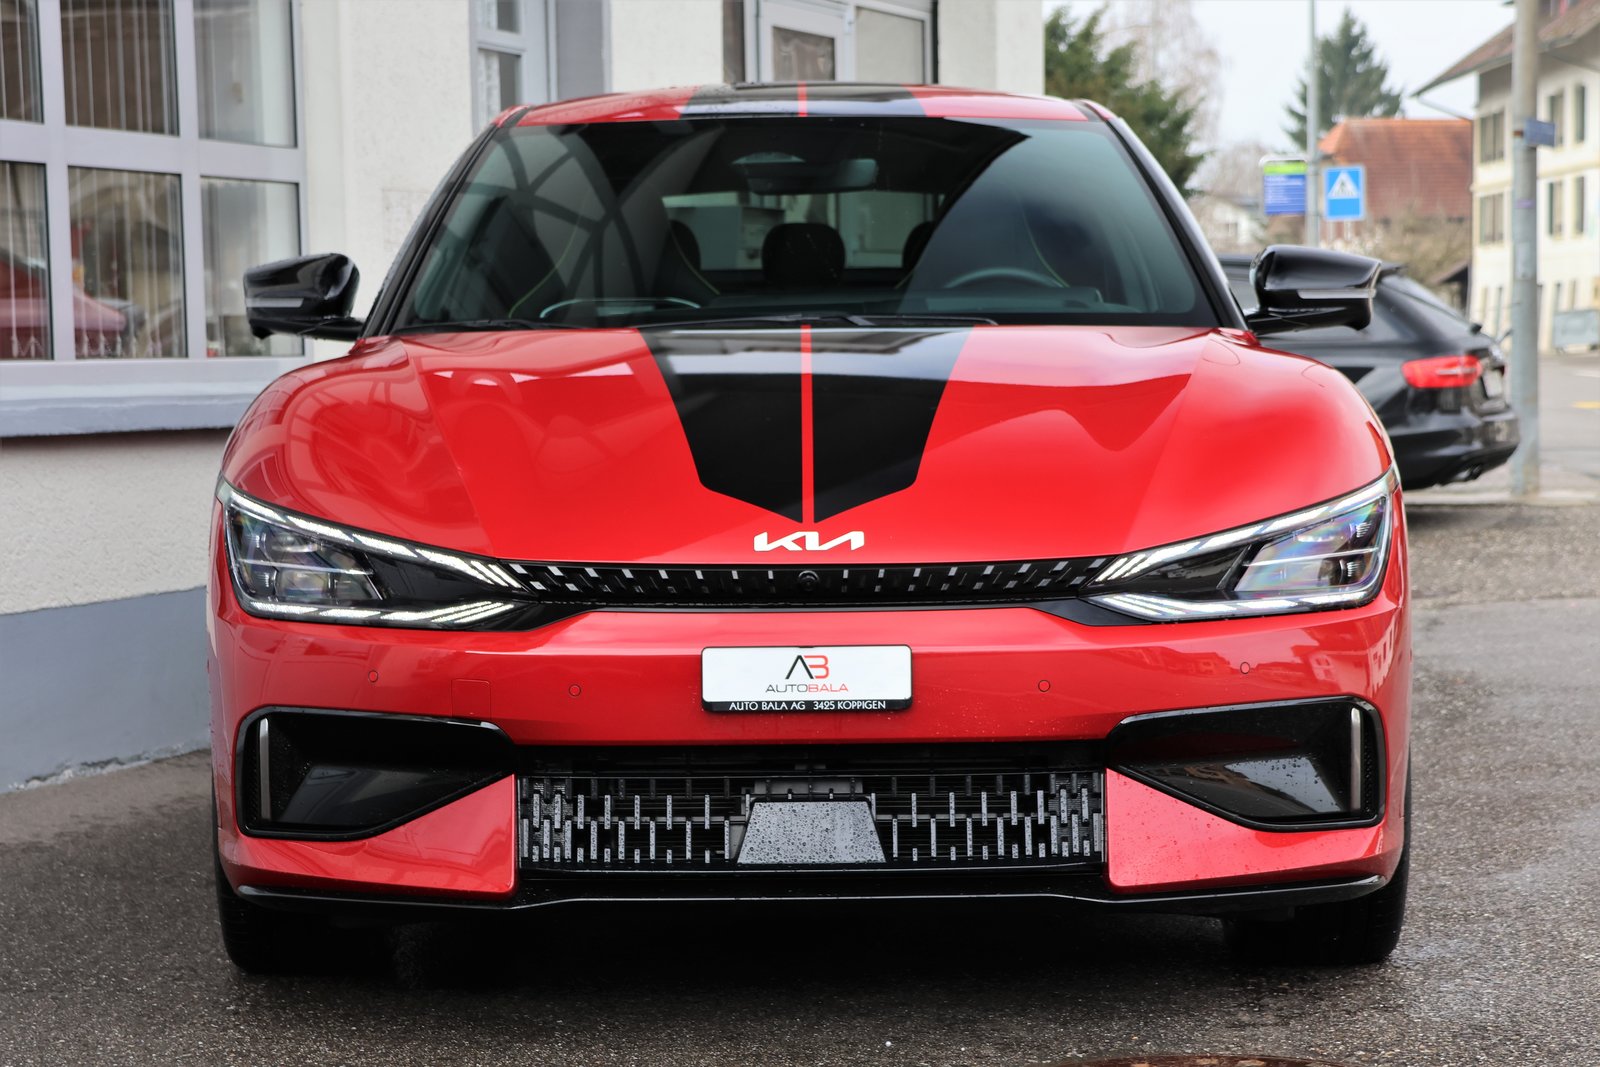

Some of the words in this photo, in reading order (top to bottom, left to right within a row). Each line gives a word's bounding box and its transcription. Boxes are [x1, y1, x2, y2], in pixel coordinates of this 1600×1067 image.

[765, 683, 849, 693] AUTOBALA
[728, 701, 759, 711] AUTO
[761, 701, 788, 711] BALA
[790, 701, 806, 711] AG
[837, 700, 886, 710] KOPPIGEN
